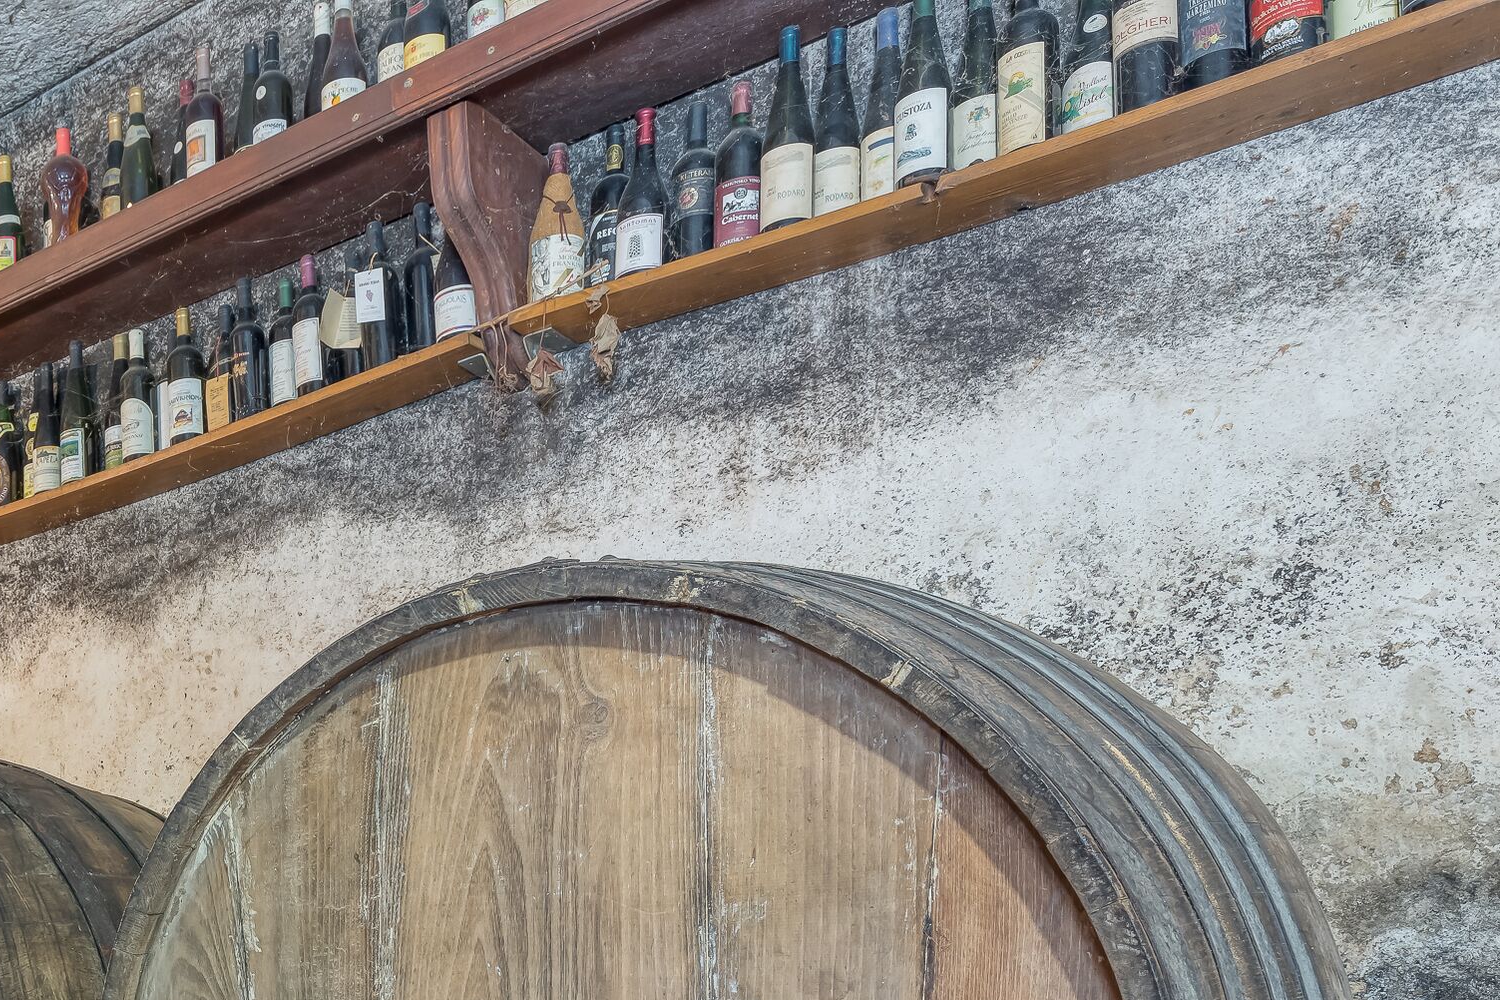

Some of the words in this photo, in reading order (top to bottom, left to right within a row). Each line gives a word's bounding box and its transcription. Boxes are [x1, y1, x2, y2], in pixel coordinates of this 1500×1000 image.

[1114, 16, 1172, 45] OLGHERI
[777, 188, 806, 199] RODARO
[824, 191, 854, 203] RODARO
[721, 212, 759, 225] Cabernet
